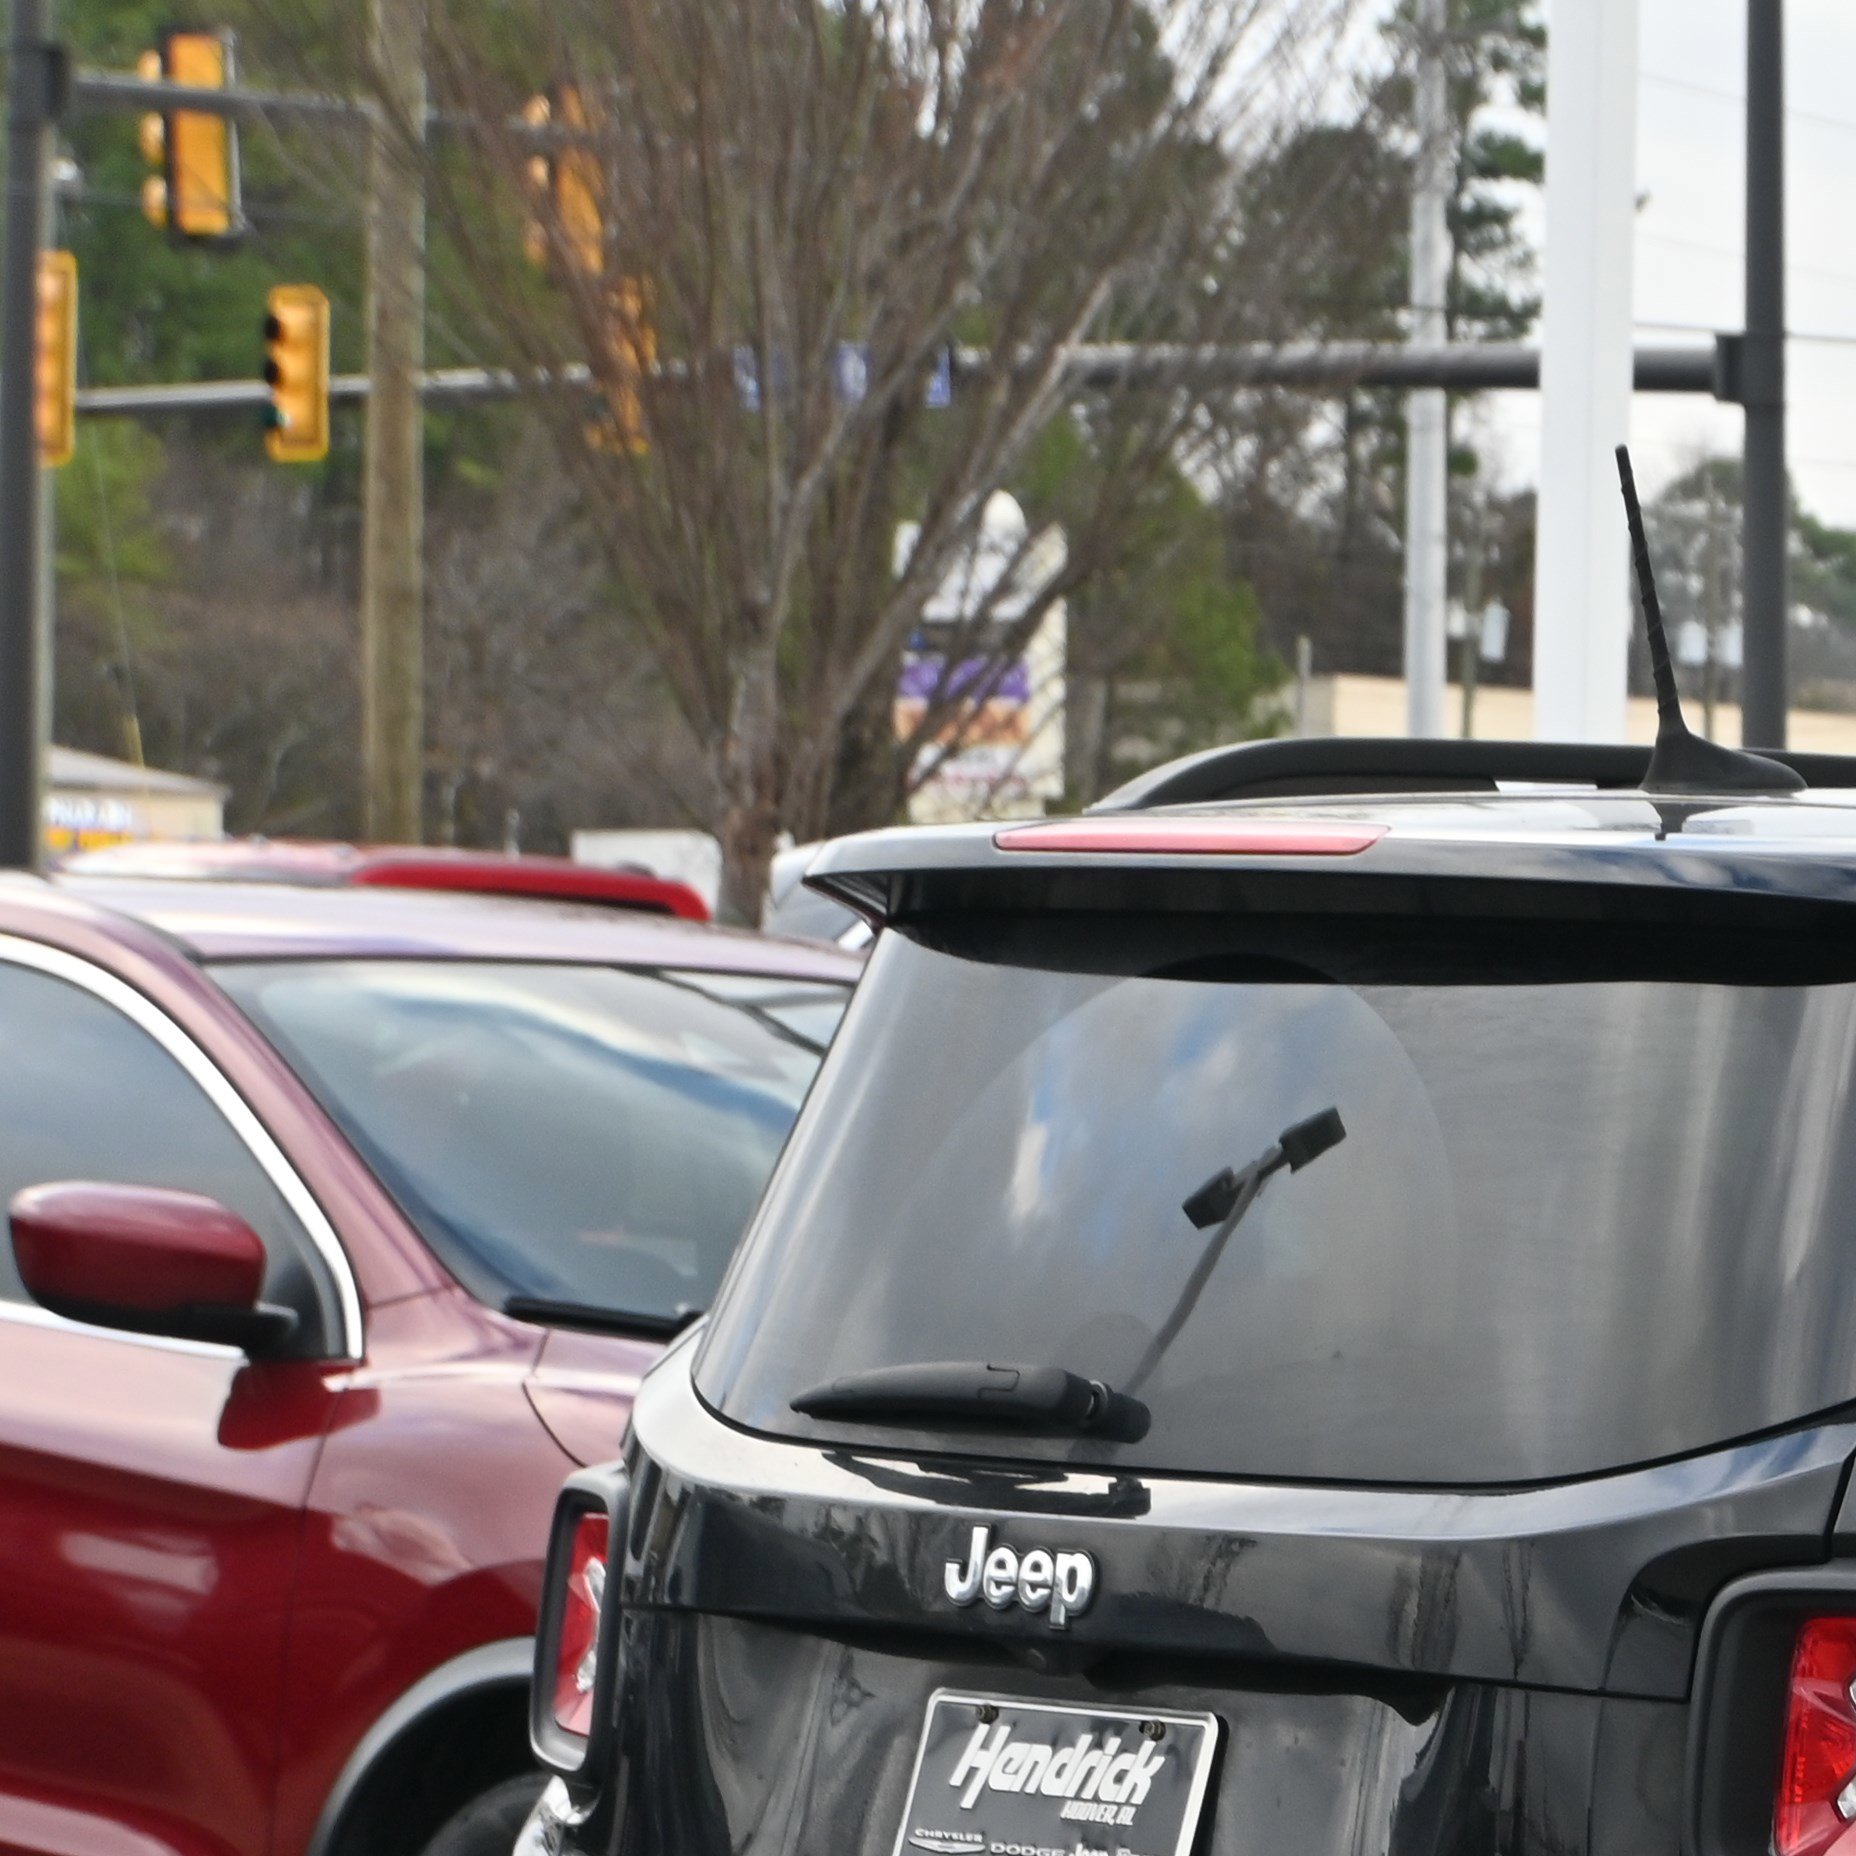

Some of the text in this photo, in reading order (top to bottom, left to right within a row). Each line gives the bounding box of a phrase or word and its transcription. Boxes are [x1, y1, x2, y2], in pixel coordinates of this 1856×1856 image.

[943, 1524, 1096, 1630] Jeep
[949, 1722, 1166, 1809] Hendrick
[914, 1827, 984, 1843] CHRYSLER
